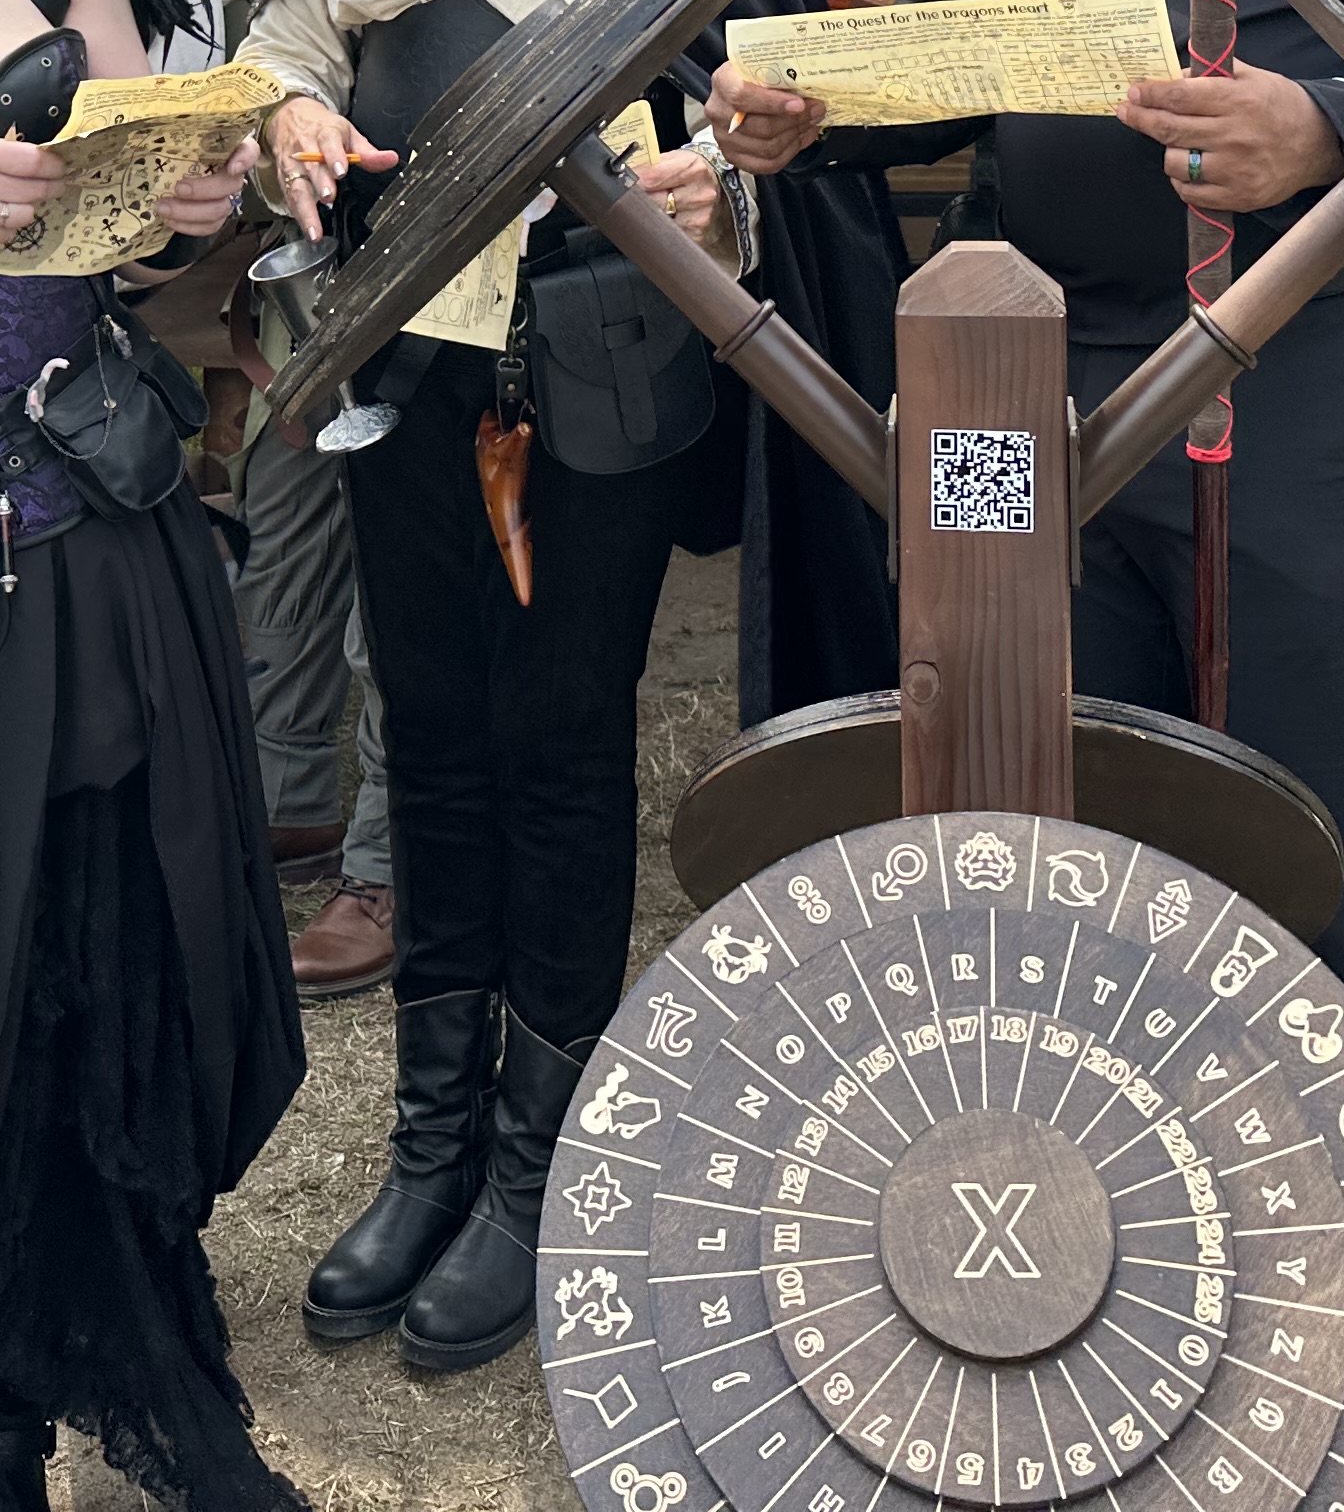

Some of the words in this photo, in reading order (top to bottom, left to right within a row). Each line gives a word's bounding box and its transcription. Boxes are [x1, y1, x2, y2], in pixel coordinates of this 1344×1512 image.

[819, 20, 844, 32] The
[847, 14, 886, 31] Quest
[891, 12, 913, 24] for
[915, 10, 940, 22] the
[942, 4, 1005, 21] Dragons
[1008, 1, 1049, 15] Heart
[180, 78, 203, 88] The
[243, 68, 266, 84] for
[267, 82, 281, 100] th
[885, 963, 918, 996] Q
[951, 954, 979, 981] R
[1020, 955, 1044, 983] S
[1093, 975, 1117, 1005] T
[825, 993, 851, 1023] P
[1144, 1008, 1176, 1038] U
[902, 1025, 941, 1056] 16
[947, 1016, 979, 1042] 17
[991, 1015, 1028, 1042] 18
[1039, 1025, 1079, 1058] 19
[776, 1035, 805, 1064] O
[857, 1045, 895, 1082] 15
[1083, 1047, 1132, 1085] 20
[1196, 1053, 1228, 1081] V
[736, 1085, 769, 1119] N
[822, 1075, 859, 1114] 14
[1123, 1078, 1164, 1118] 21
[795, 1117, 829, 1156] 13
[1234, 1108, 1272, 1145] W
[1157, 1119, 1197, 1169] 22
[706, 1153, 738, 1189] M
[777, 1164, 810, 1205] 12
[1184, 1166, 1218, 1215] 23
[1261, 1181, 1296, 1215] X
[698, 1228, 726, 1251] L
[774, 1222, 801, 1254] 11
[951, 1182, 1041, 1279] X
[1196, 1216, 1226, 1265] 24
[776, 1266, 806, 1308] 10
[1276, 1257, 1307, 1286] Y
[700, 1295, 732, 1328] K
[1194, 1273, 1225, 1324] 25
[794, 1327, 825, 1358] 9
[1178, 1334, 1209, 1366] 0
[1270, 1328, 1304, 1362] Z
[823, 1372, 855, 1405] 8
[1150, 1378, 1183, 1410] 1
[860, 1414, 893, 1447] 7
[1108, 1413, 1143, 1451] 2
[906, 1439, 937, 1473] 6
[956, 1452, 985, 1486] 5
[1064, 1442, 1096, 1476] 3
[1016, 1457, 1044, 1490] 4
[1208, 1456, 1243, 1494] B
